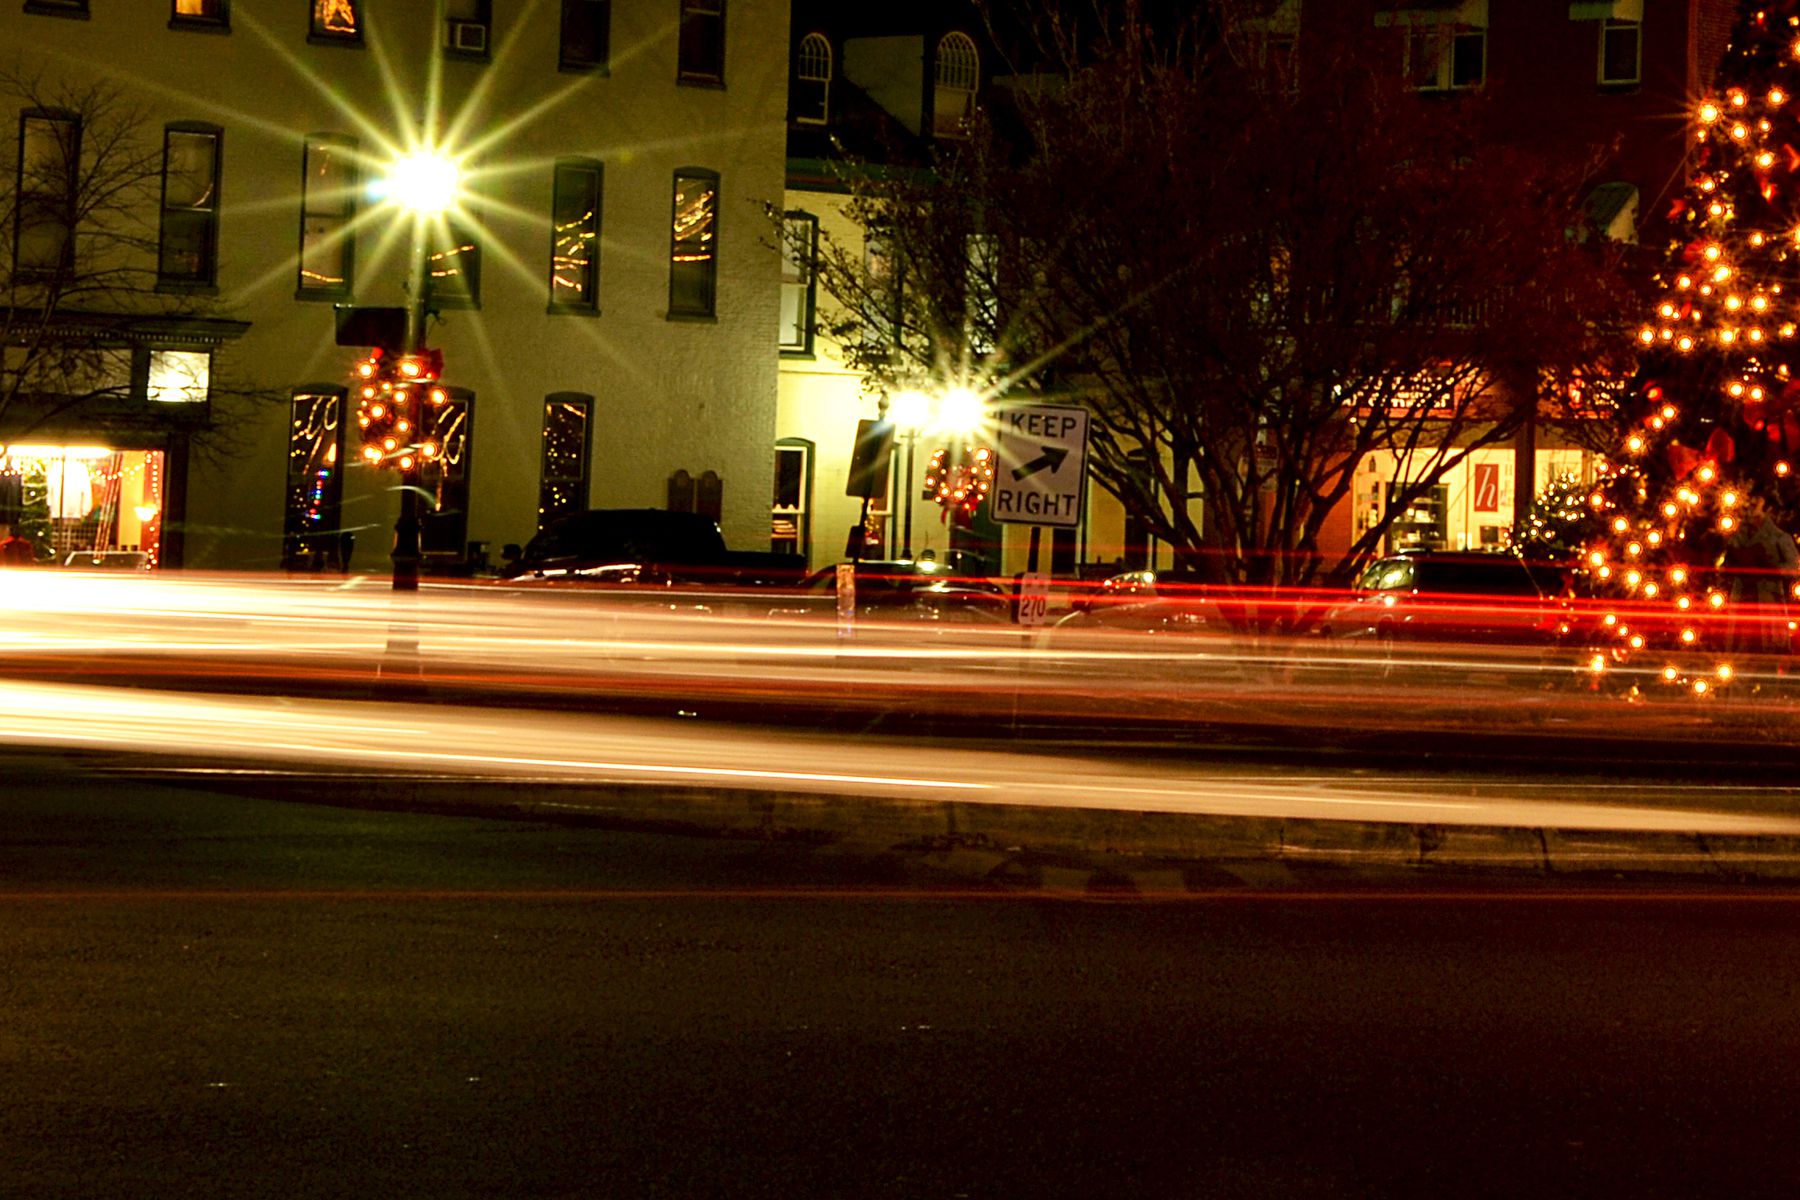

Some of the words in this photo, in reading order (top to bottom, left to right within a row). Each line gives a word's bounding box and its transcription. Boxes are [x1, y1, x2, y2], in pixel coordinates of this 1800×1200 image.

[1010, 413, 1076, 438] KEEP
[997, 490, 1076, 517] RIGHT
[1021, 596, 1046, 617] 270
